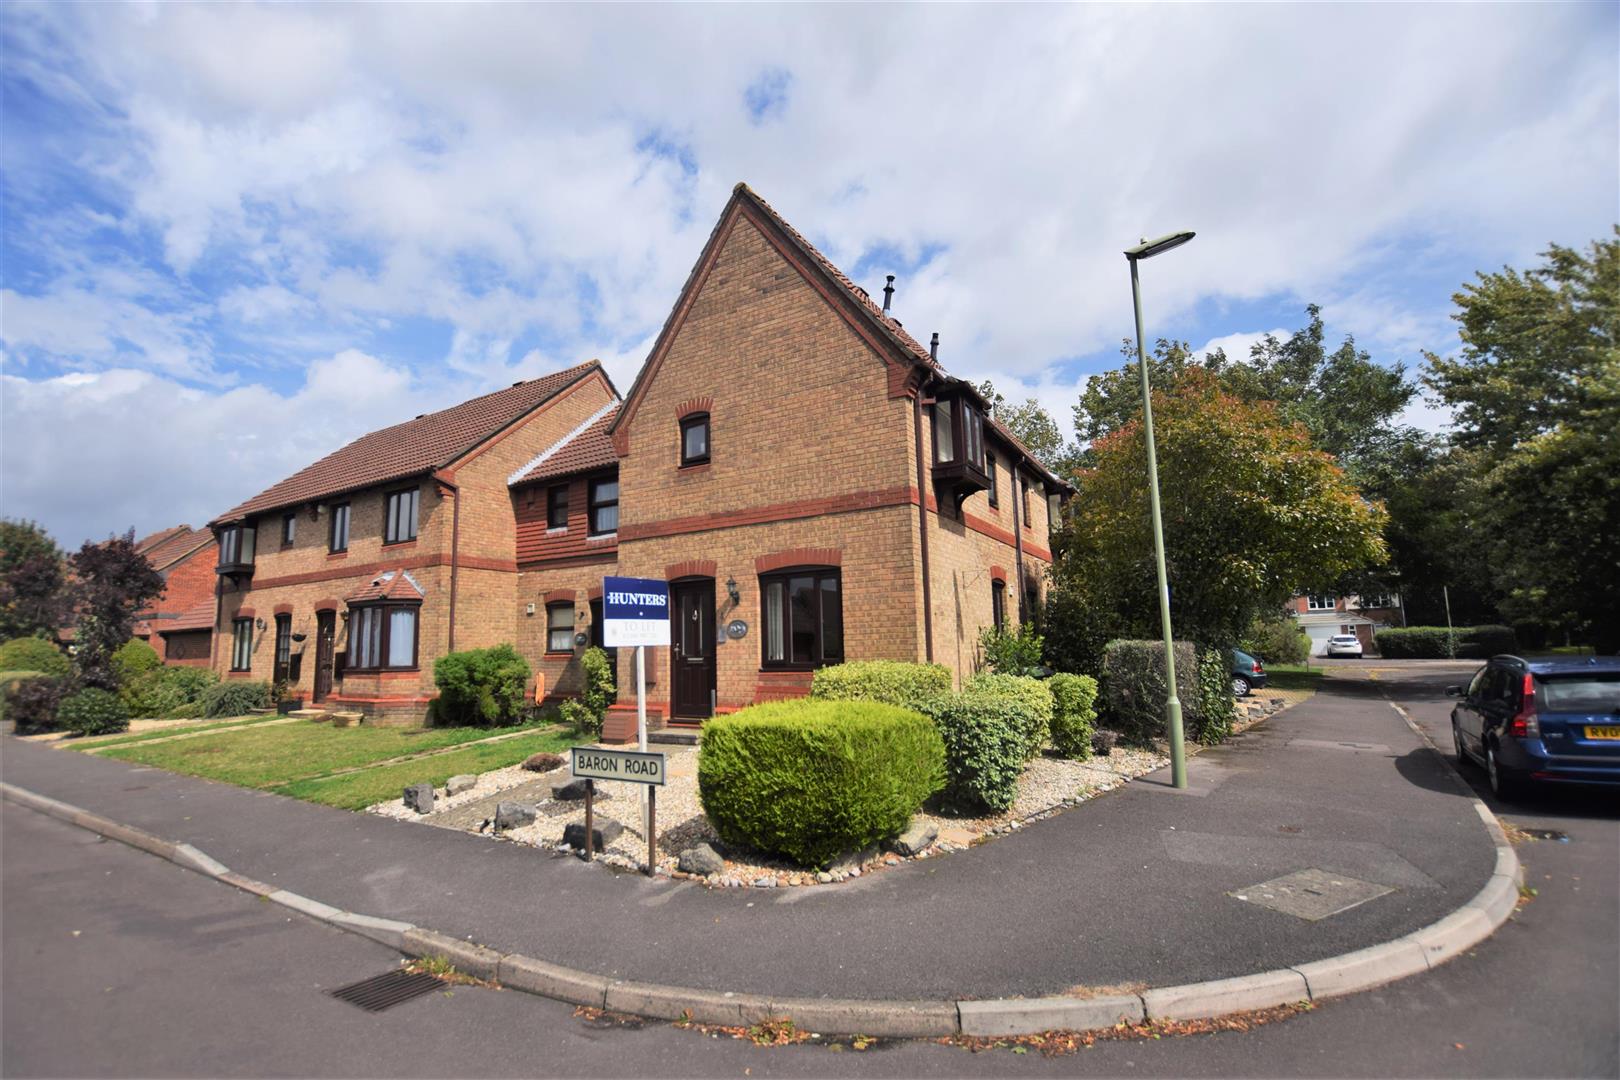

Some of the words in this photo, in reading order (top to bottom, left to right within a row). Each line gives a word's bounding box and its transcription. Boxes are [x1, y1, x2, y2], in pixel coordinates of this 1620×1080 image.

[607, 592, 667, 606] HUNTERS
[624, 621, 638, 632] TO
[641, 621, 657, 632] LET
[578, 755, 618, 772] BARON
[625, 759, 658, 776] ROAD
